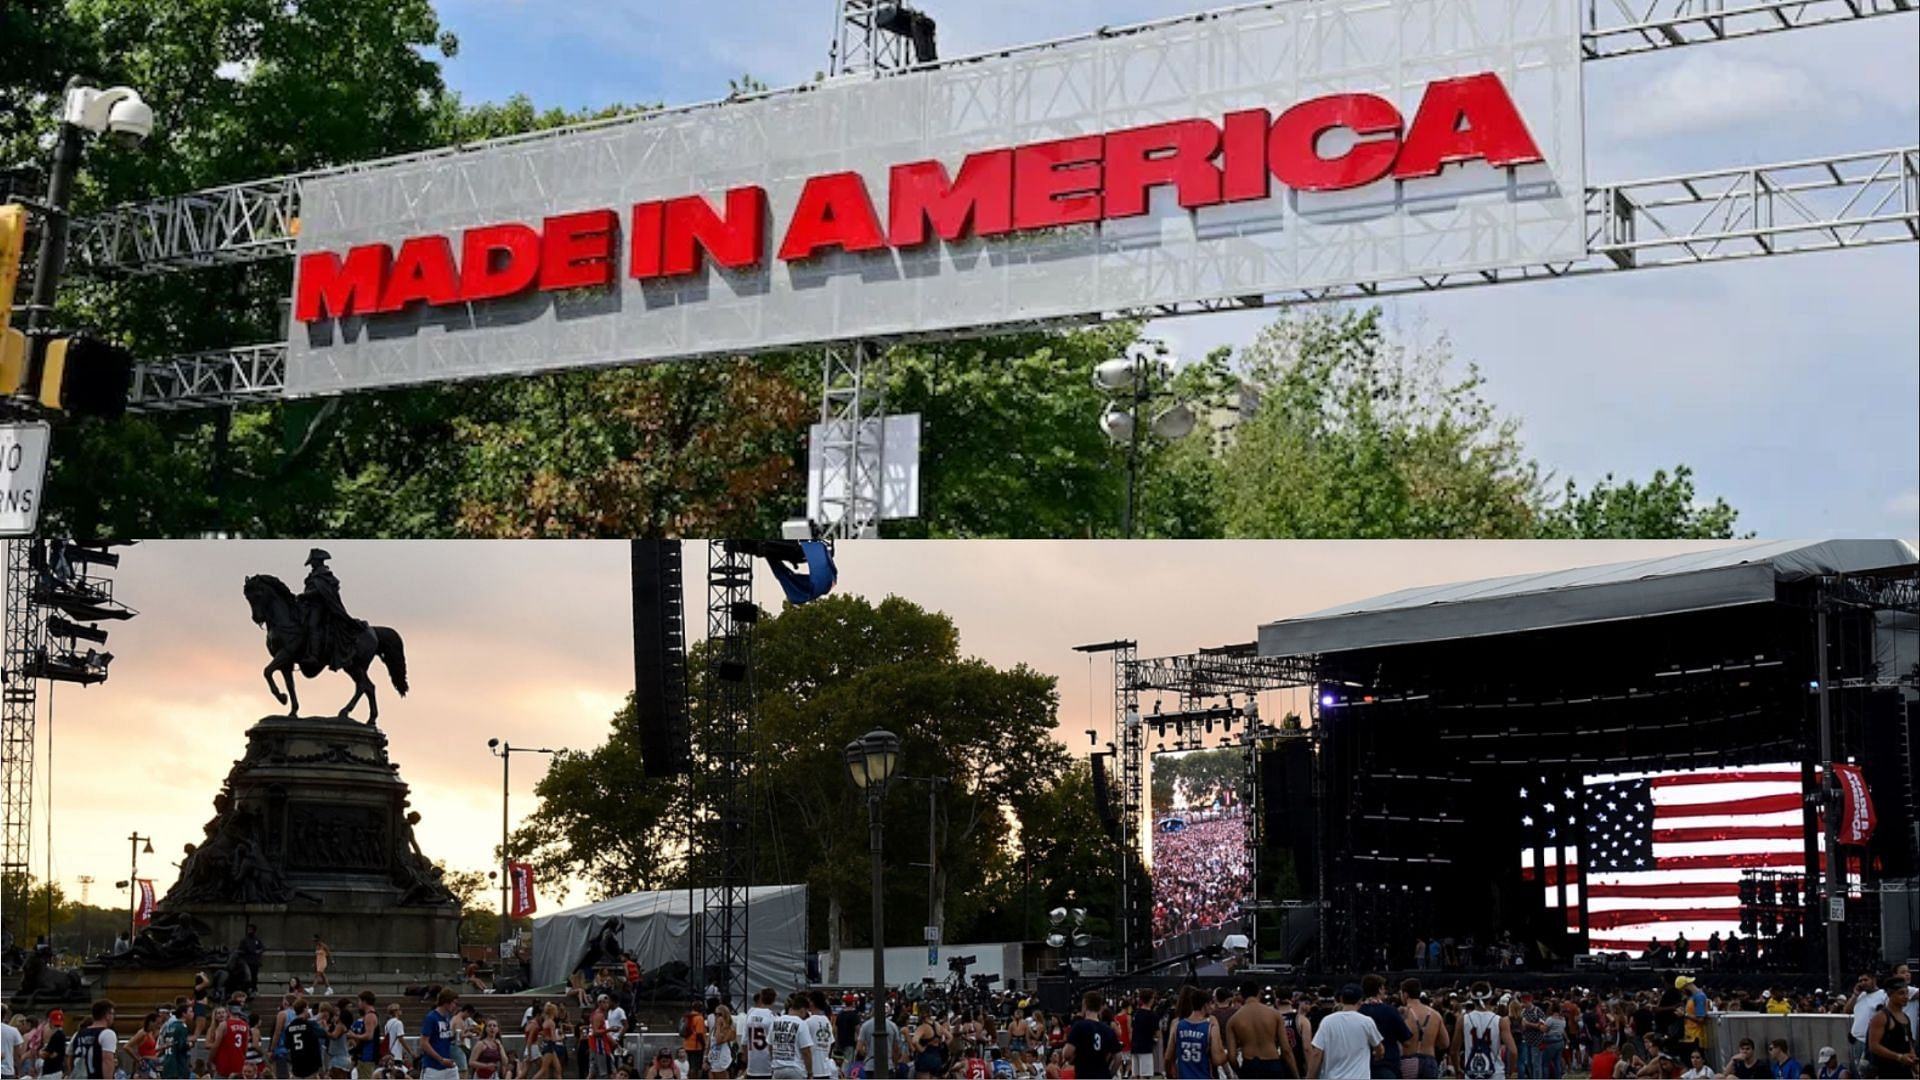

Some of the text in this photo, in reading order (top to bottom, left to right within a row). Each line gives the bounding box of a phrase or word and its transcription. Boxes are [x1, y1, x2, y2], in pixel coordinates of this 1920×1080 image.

[295, 71, 1544, 321] MADE IN AMERICA
[234, 1033, 243, 1048] 3
[293, 1032, 304, 1050] 5
[748, 1027, 768, 1051] 15
[1093, 1033, 1102, 1051] 3
[1180, 1041, 1202, 1062] 35
